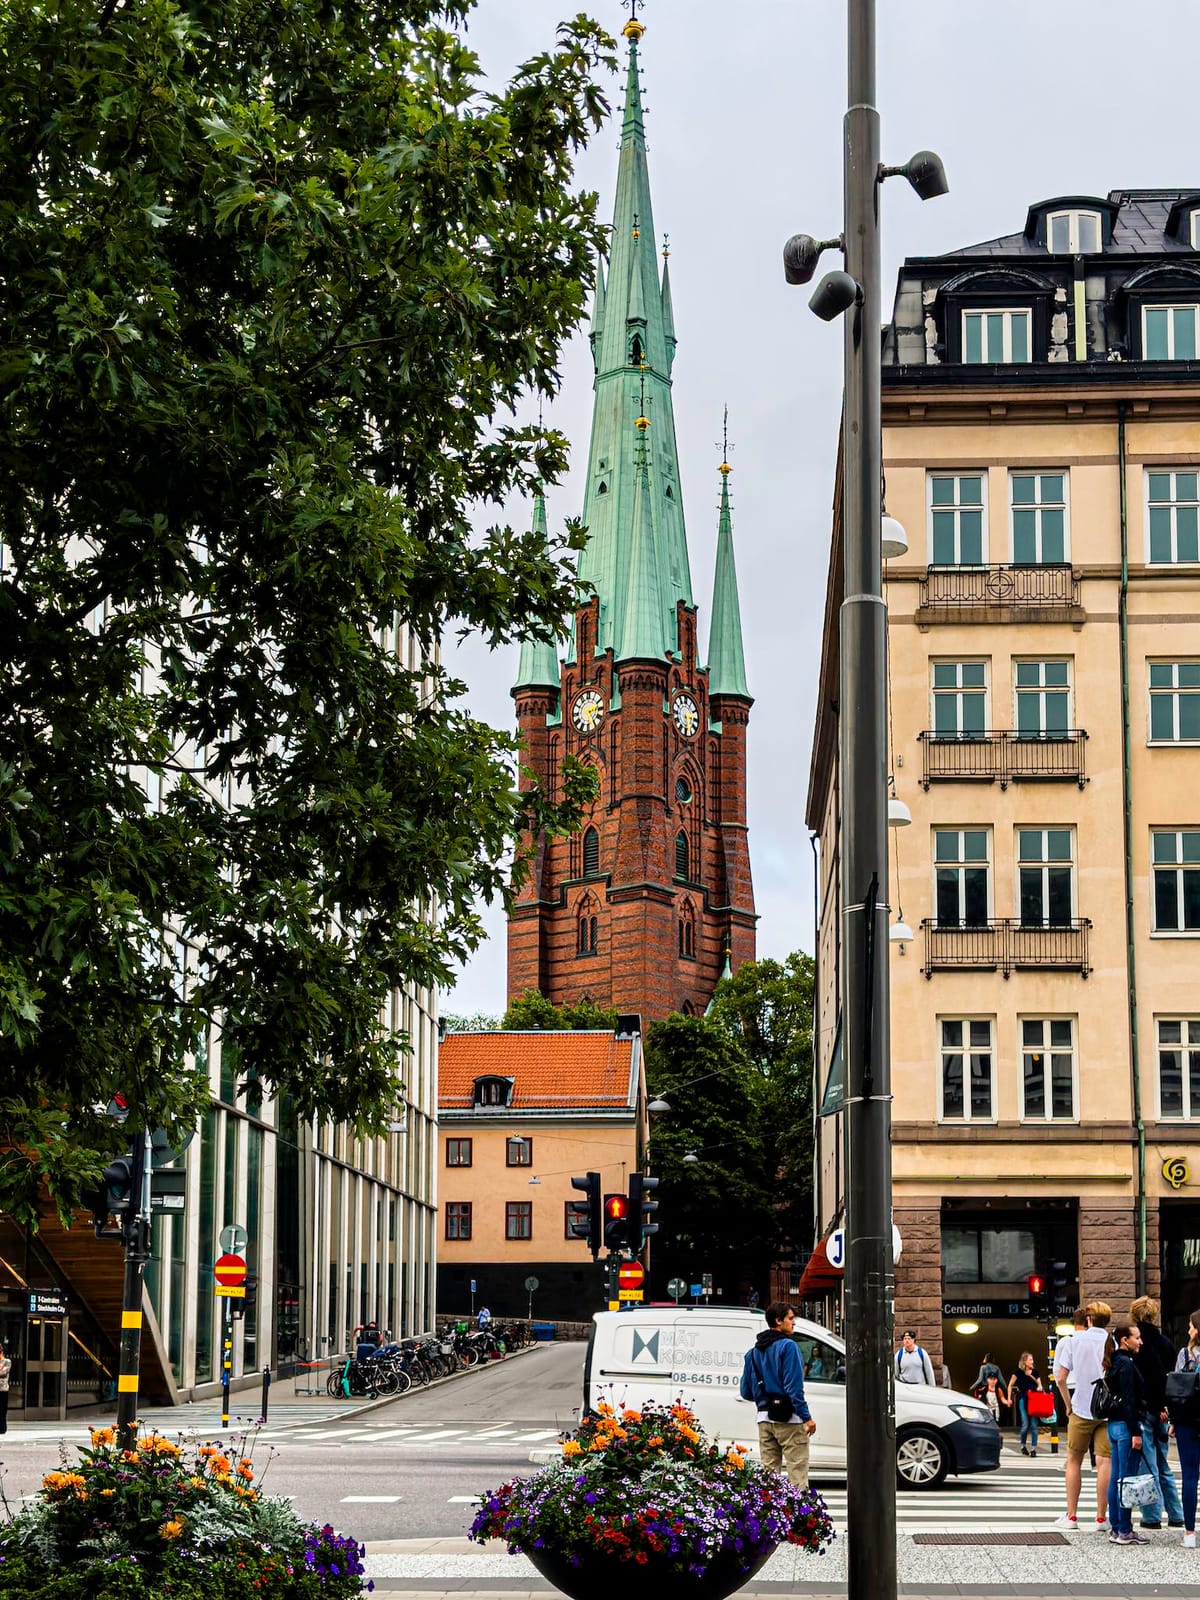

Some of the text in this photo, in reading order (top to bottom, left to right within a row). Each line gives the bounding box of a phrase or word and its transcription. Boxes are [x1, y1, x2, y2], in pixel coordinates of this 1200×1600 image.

[832, 1233, 843, 1264] J
[660, 1329, 699, 1347] MÄT
[659, 1348, 745, 1367] KONSULT
[672, 1372, 739, 1386] 08-645 19 0
